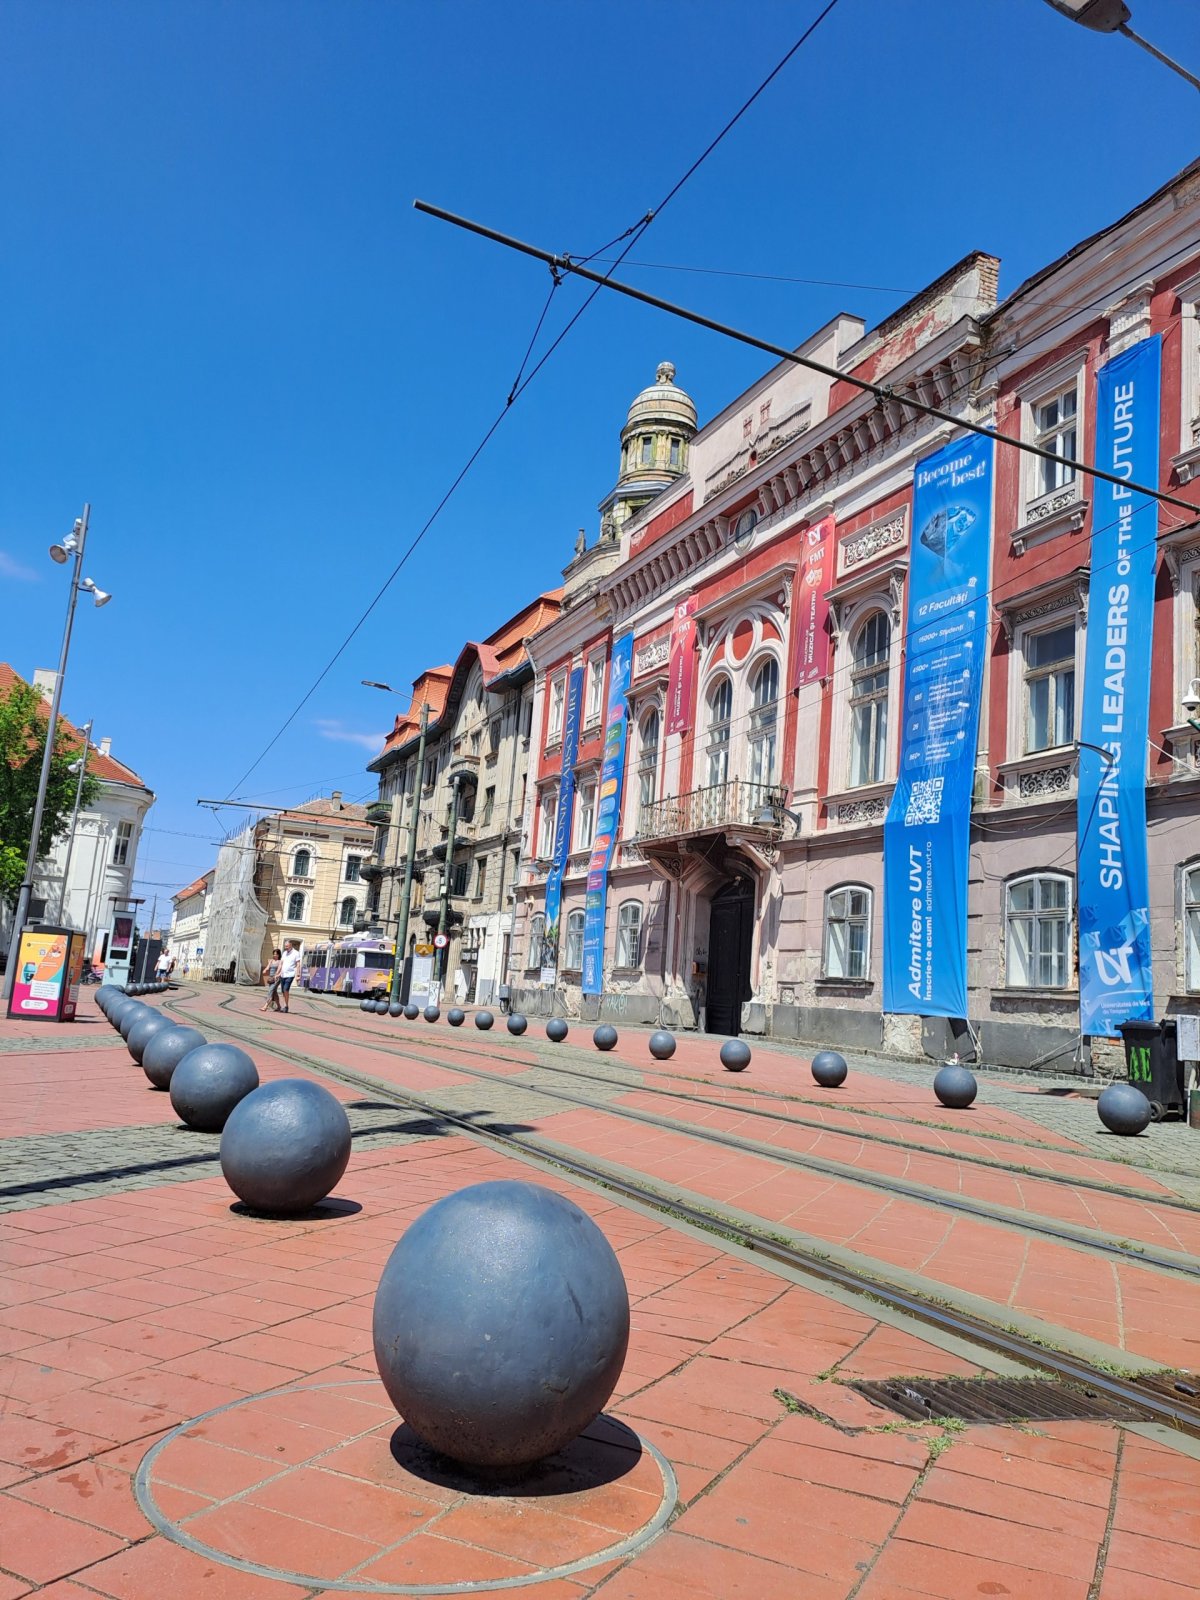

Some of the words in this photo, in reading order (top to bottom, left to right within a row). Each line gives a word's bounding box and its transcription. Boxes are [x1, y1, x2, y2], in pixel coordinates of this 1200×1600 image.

[1113, 381, 1134, 501] FUTURE
[917, 454, 973, 489] Become
[951, 460, 986, 488] best!
[1118, 504, 1132, 544] THE
[809, 547, 825, 565] FMT
[1117, 549, 1131, 576] OF
[918, 605, 928, 617] 12
[808, 631, 816, 664] MUZICĂ
[1102, 585, 1129, 732] LEADERS
[1098, 742, 1122, 890] SHAPING
[909, 845, 923, 893] UVT
[908, 898, 922, 1000] Admitere
